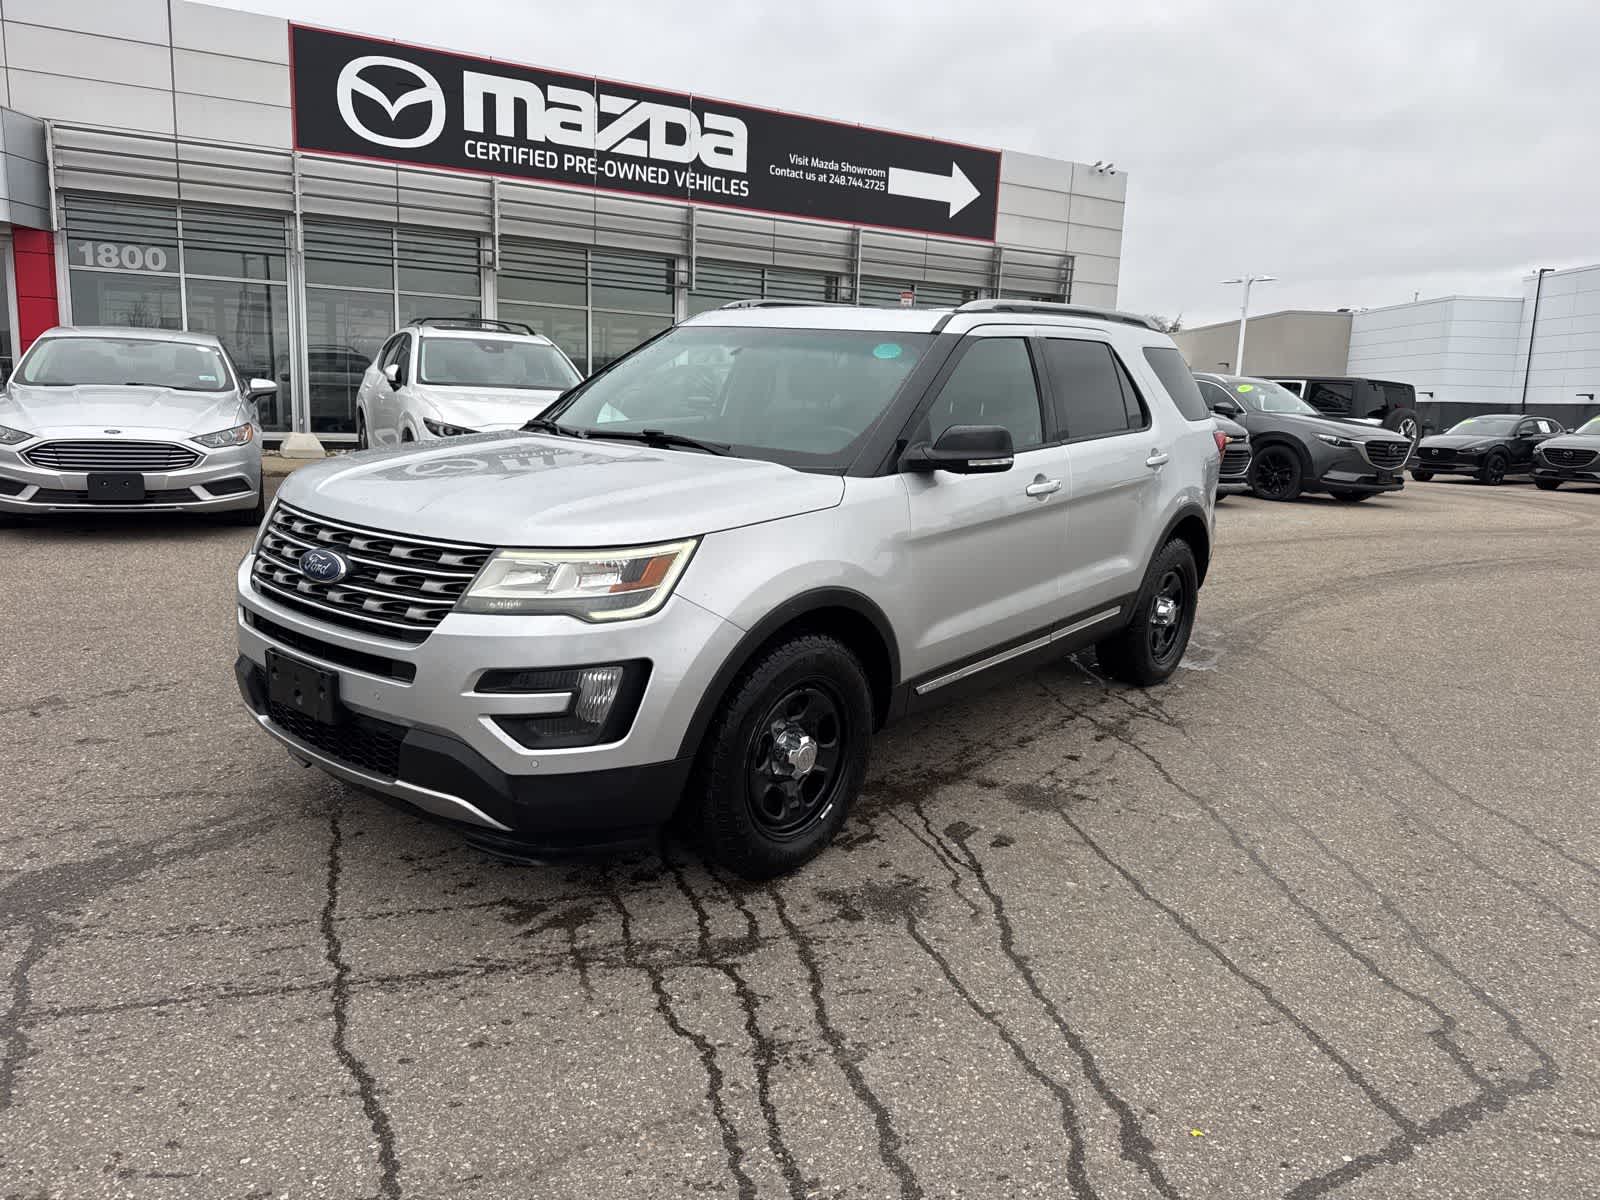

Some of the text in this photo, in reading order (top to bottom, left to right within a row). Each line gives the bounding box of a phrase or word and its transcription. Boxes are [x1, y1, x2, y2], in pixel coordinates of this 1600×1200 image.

[464, 139, 750, 197] CERTIFIED PRE-OWNED VEHICLES
[769, 164, 886, 191] Contact us at 248.744.2725
[789, 153, 886, 178] Visit Mazda Showroom
[78, 241, 167, 271] 1800
[304, 553, 332, 575] Ford
